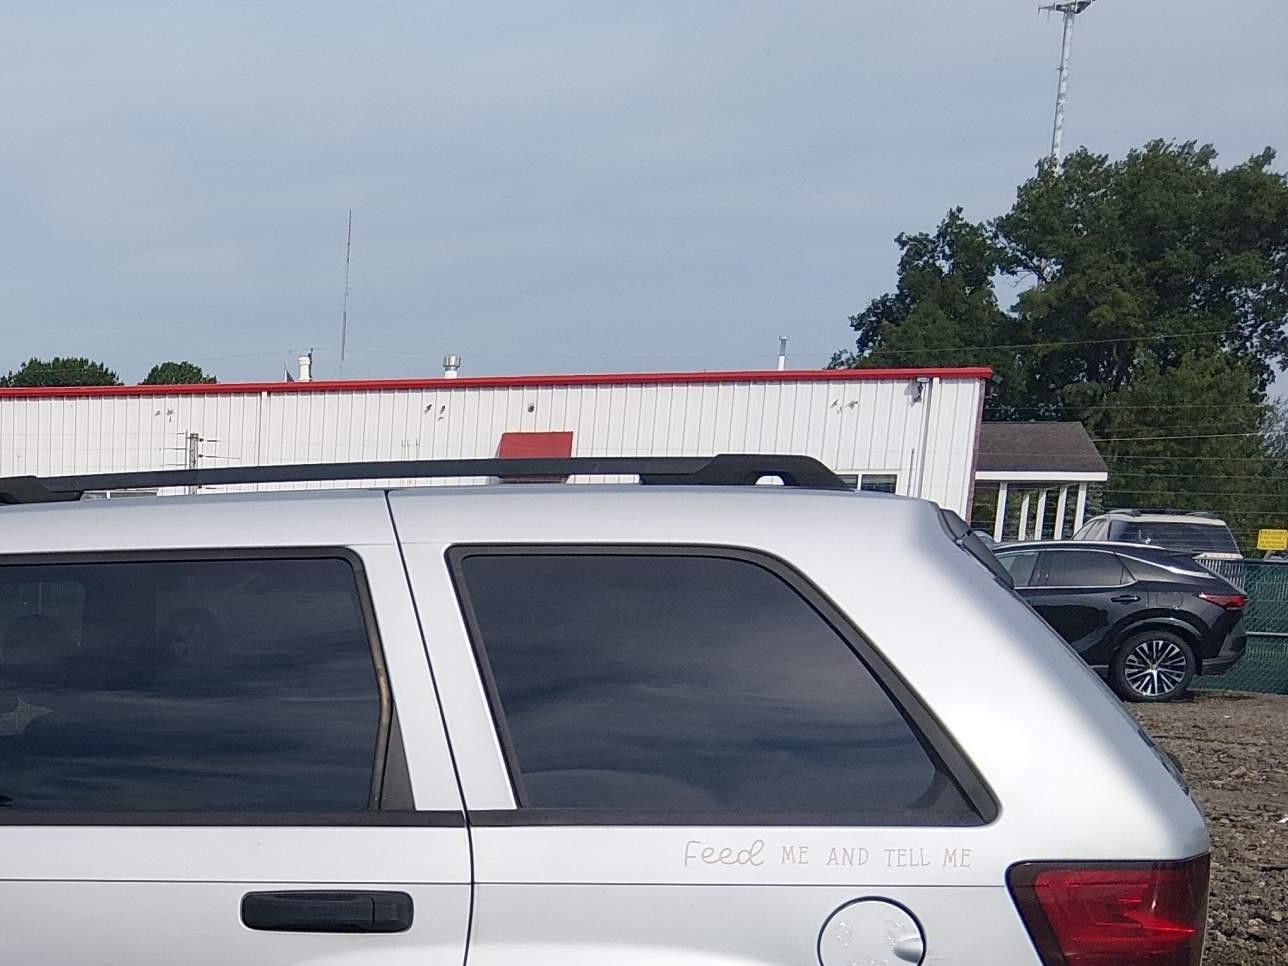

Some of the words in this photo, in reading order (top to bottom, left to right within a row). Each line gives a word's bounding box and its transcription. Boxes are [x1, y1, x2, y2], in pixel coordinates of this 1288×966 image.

[683, 839, 765, 867] Feed
[780, 845, 809, 865] ME
[825, 847, 869, 866] AND
[883, 848, 931, 867] TELL
[942, 848, 972, 868] ME
